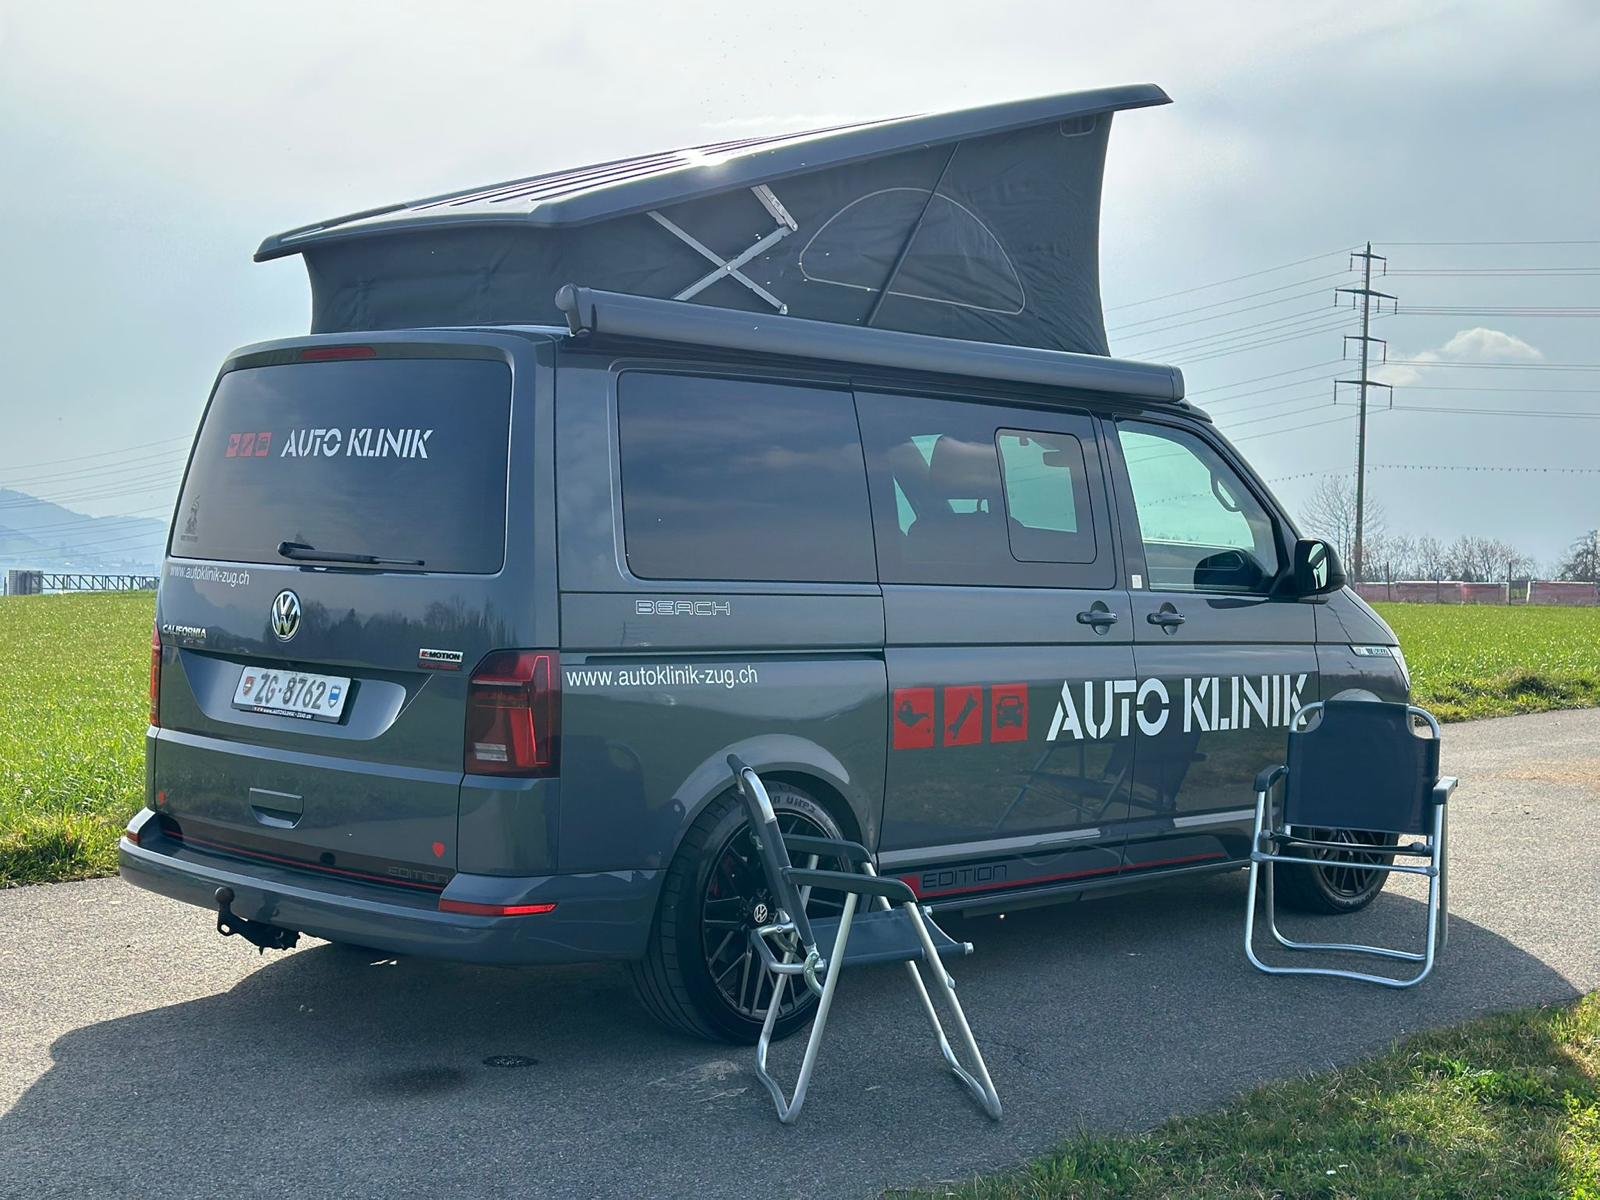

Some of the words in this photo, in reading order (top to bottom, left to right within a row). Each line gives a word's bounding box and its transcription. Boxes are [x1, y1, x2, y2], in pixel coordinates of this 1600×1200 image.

[280, 427, 342, 458] AUTO
[346, 428, 434, 459] KLINIK
[169, 565, 251, 588] www.autoklinik-zug.ch
[635, 600, 731, 616] BEACH
[162, 624, 207, 639] CALIFORNIA
[566, 664, 759, 689] www.autoklinik-zug.ch
[1046, 677, 1170, 741] AUTO
[1183, 673, 1308, 733] KLINIK
[922, 864, 1008, 889] EDITION
